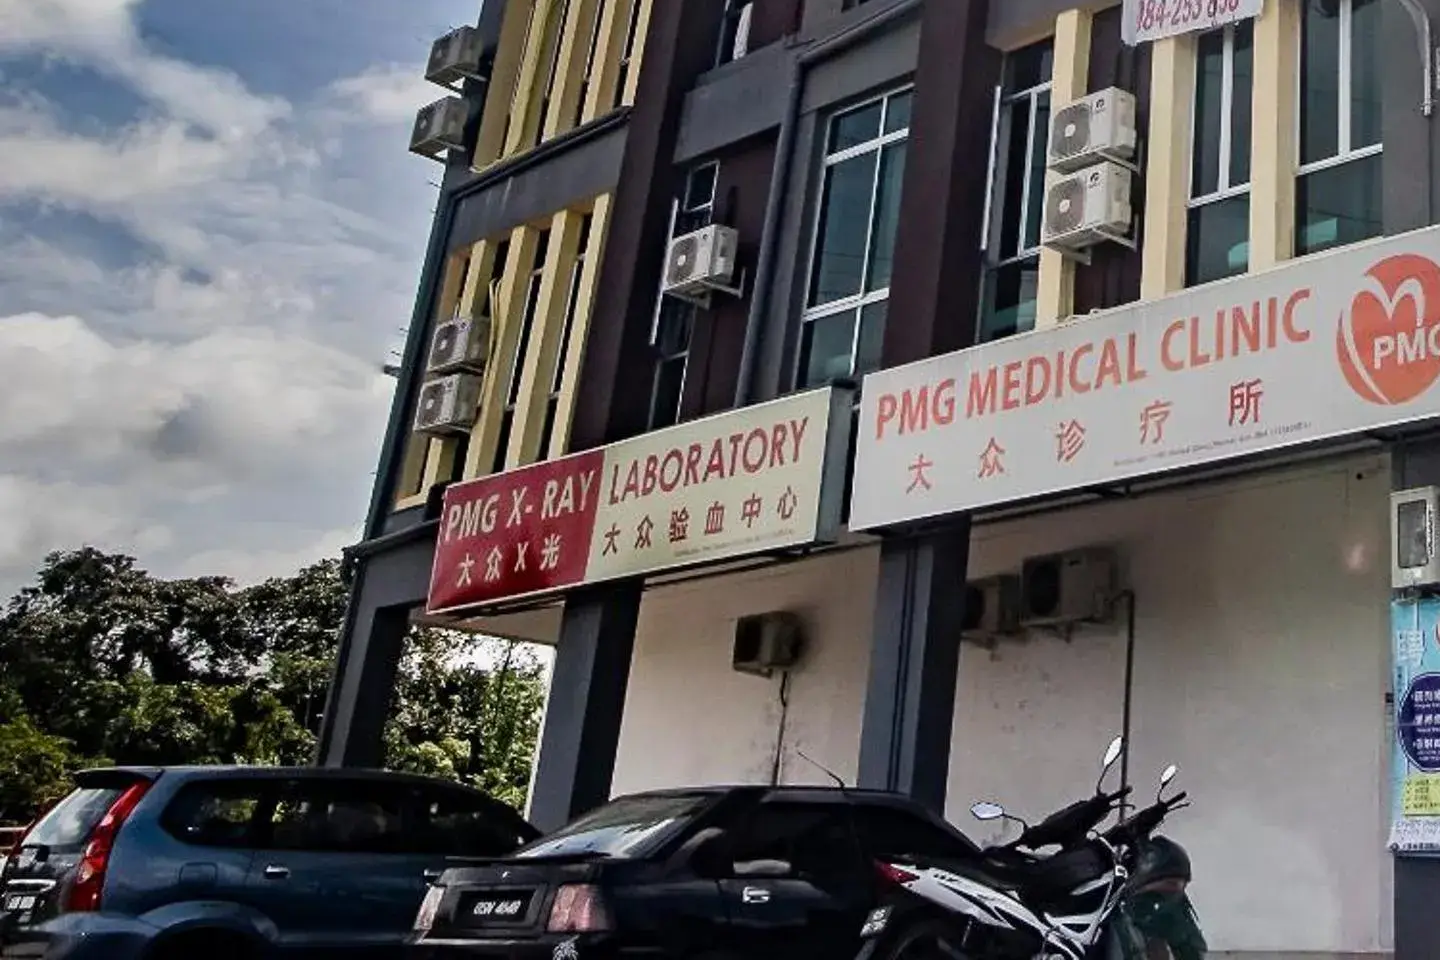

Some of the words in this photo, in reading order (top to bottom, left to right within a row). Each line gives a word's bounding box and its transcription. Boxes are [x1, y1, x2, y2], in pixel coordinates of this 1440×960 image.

[876, 378, 955, 440] PMG
[967, 332, 1149, 419] MEDICAL
[1161, 289, 1312, 370] CLINIC
[609, 416, 809, 506] LABORATORY
[906, 379, 1264, 494] 大众诊疗所
[446, 498, 499, 542] PMG
